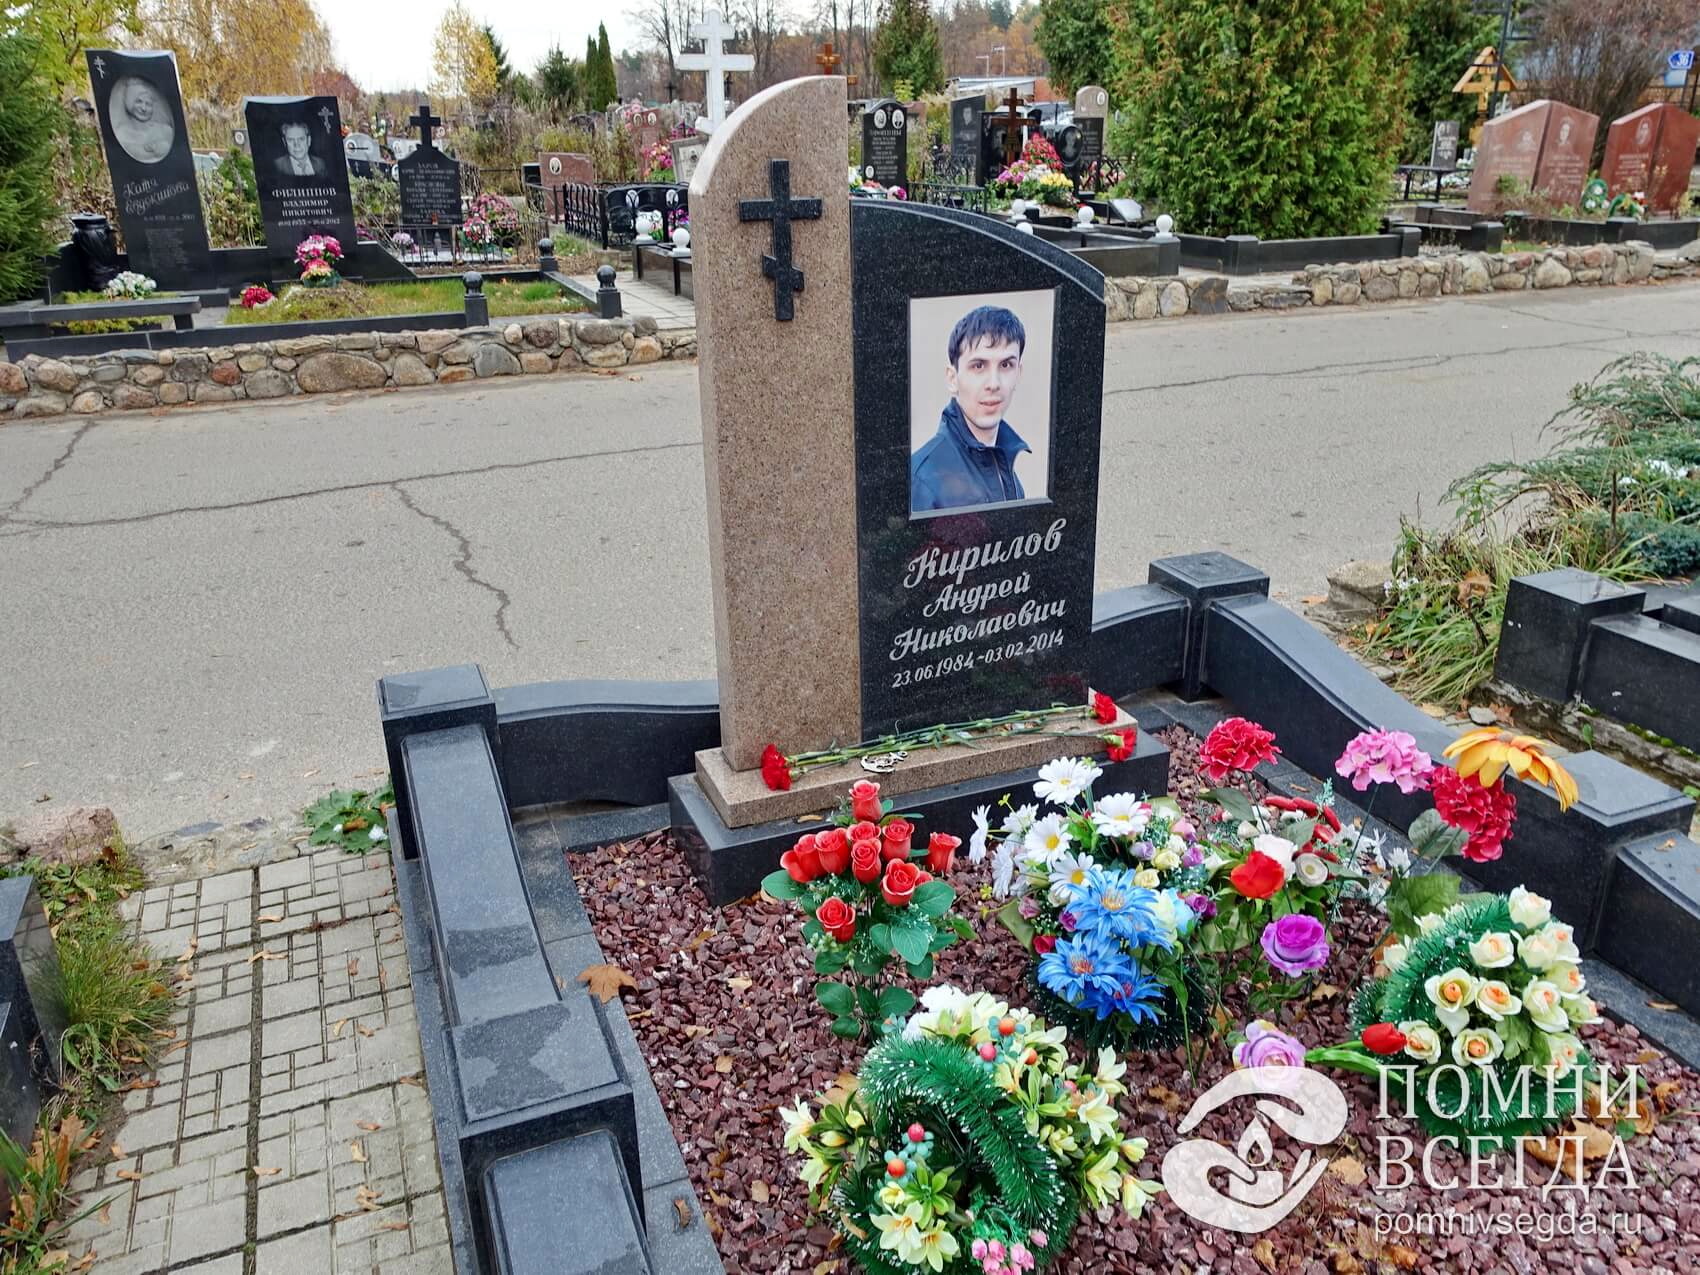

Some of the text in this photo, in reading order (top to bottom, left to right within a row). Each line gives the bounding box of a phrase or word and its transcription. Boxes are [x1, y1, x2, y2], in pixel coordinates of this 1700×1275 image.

[272, 187, 337, 198] ФИЛИППОВ
[903, 518, 1067, 588] Кирилов
[923, 571, 1031, 617] Андрей
[889, 600, 1067, 661] Николаевич
